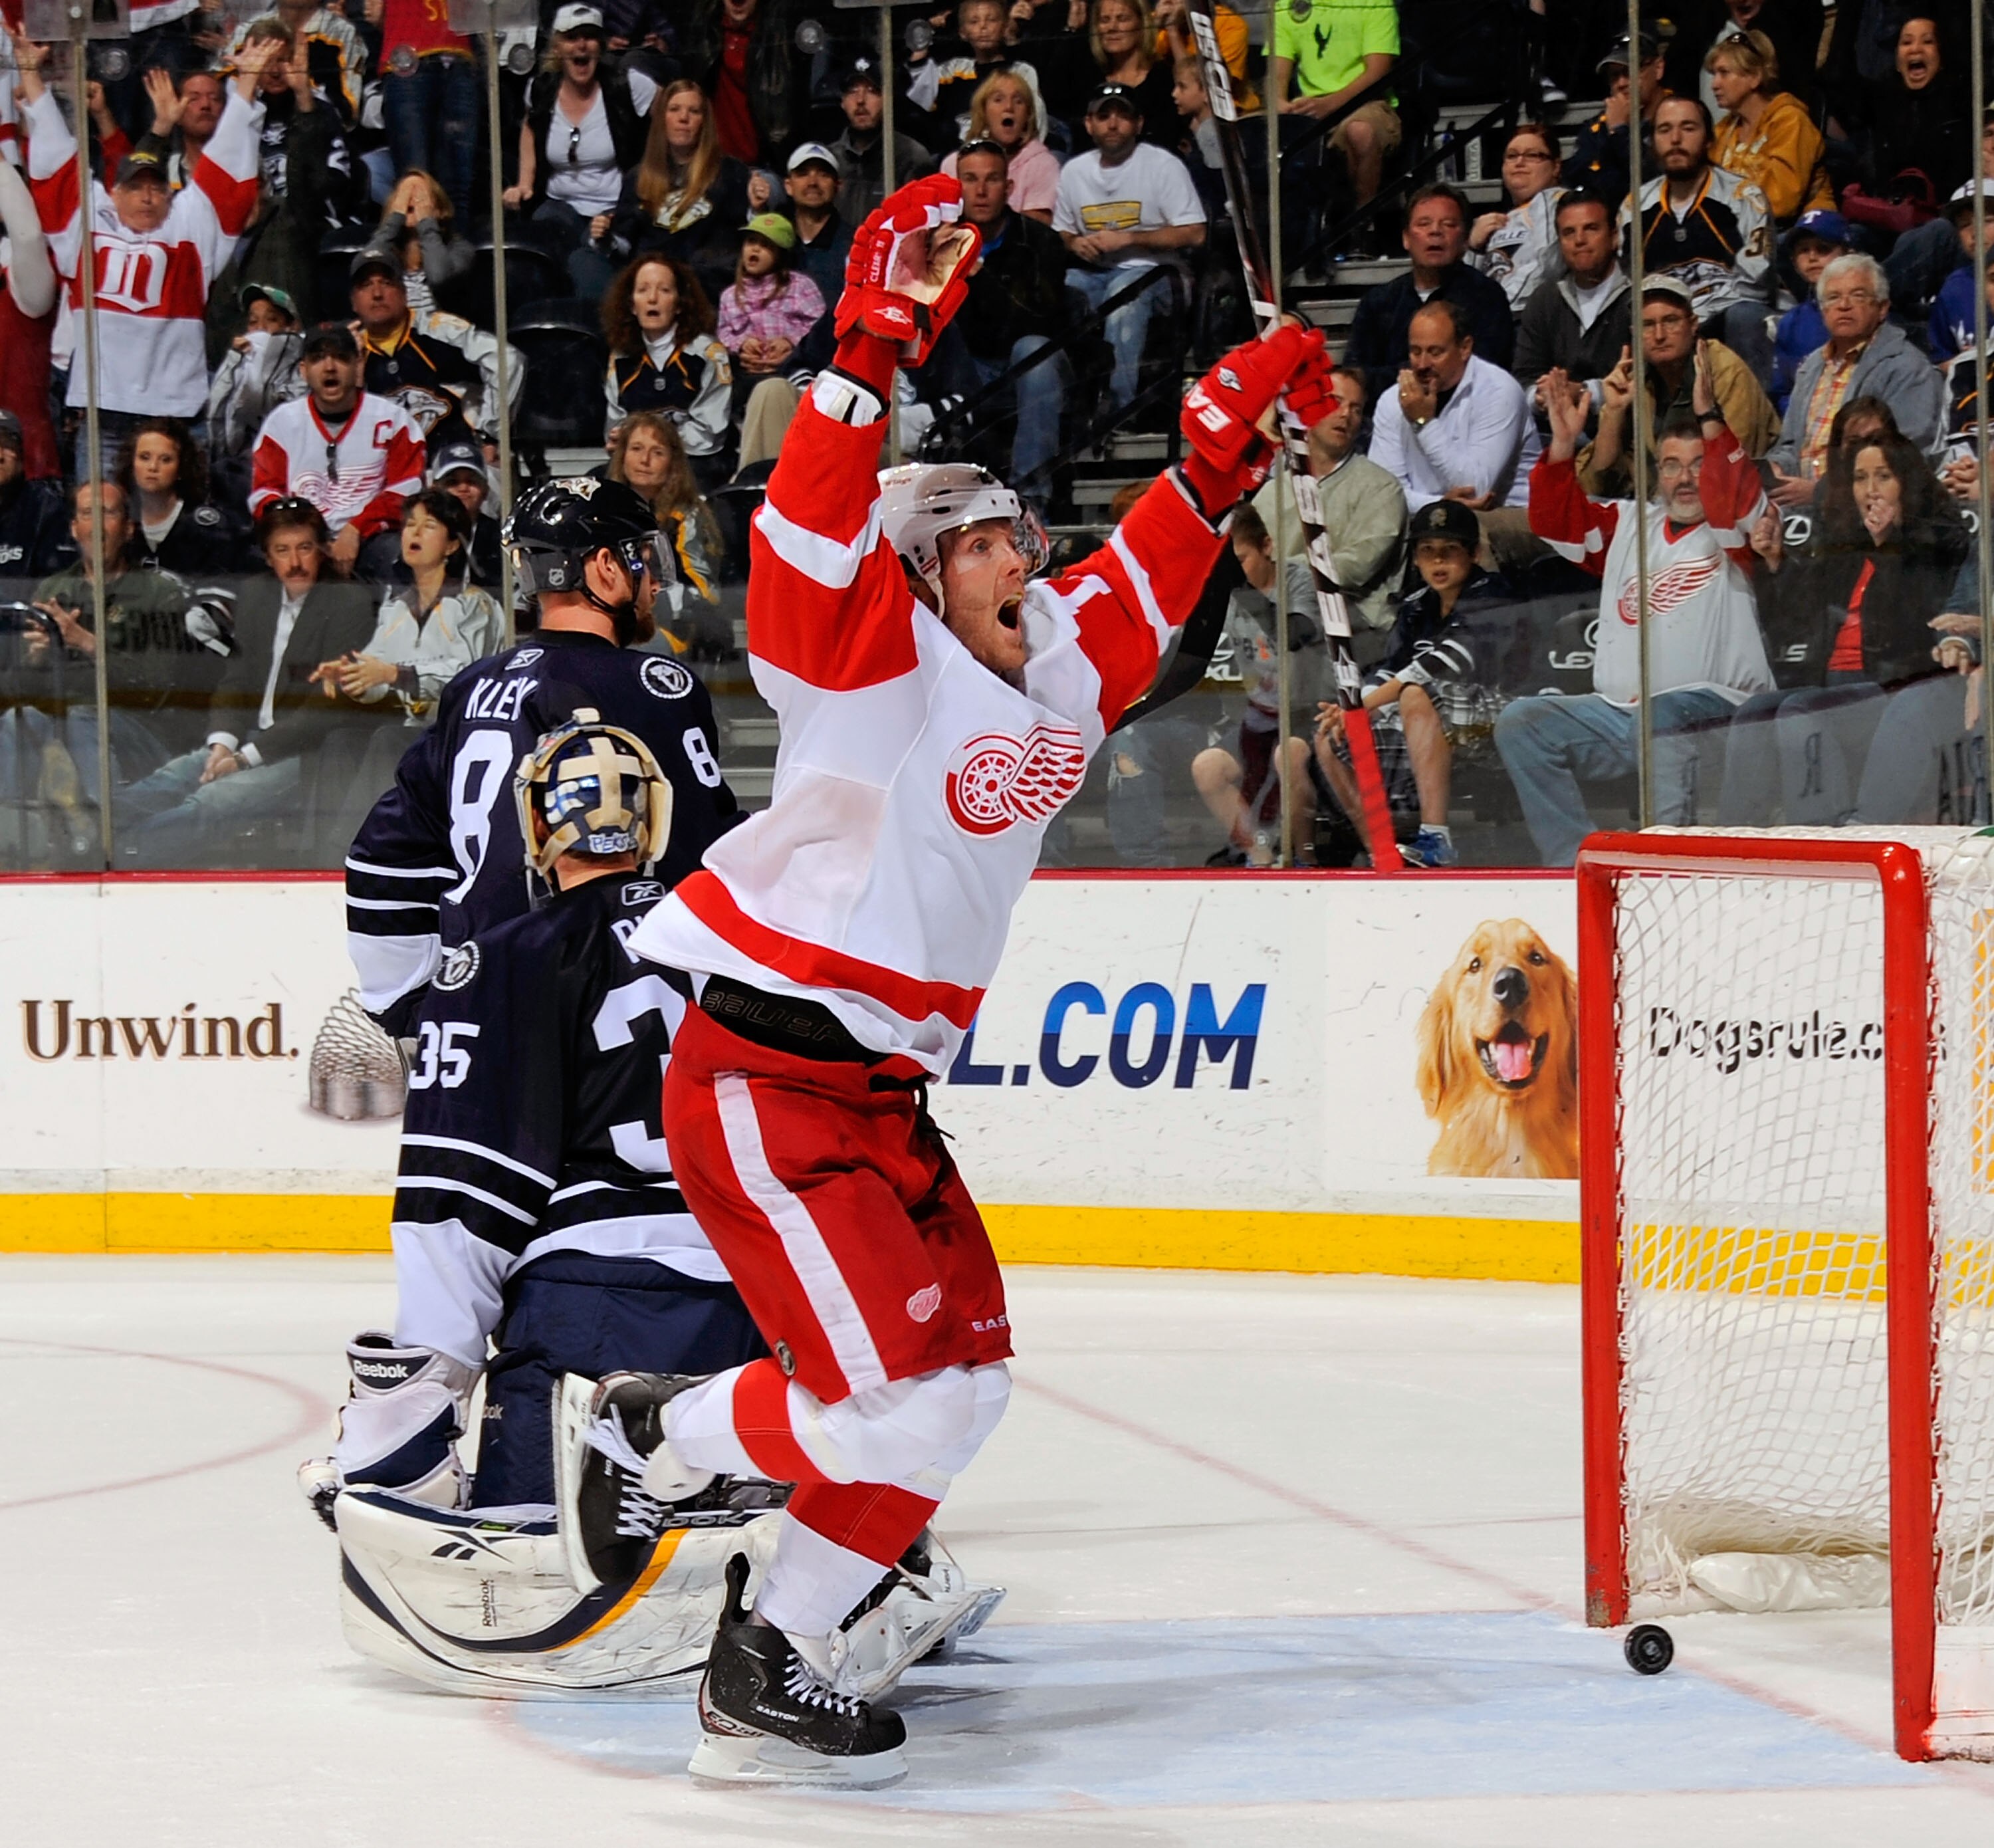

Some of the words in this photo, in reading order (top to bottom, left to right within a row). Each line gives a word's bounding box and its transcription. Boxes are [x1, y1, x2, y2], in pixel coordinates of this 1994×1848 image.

[1803, 210, 1822, 224] T
[373, 419, 393, 450] C
[683, 727, 721, 788] 8
[21, 998, 300, 1062] Unwind.
[408, 1020, 481, 1090] 35
[353, 1359, 408, 1378] Reebok
[479, 1578, 493, 1627] Reebok
[755, 1704, 800, 1723] EASTON
